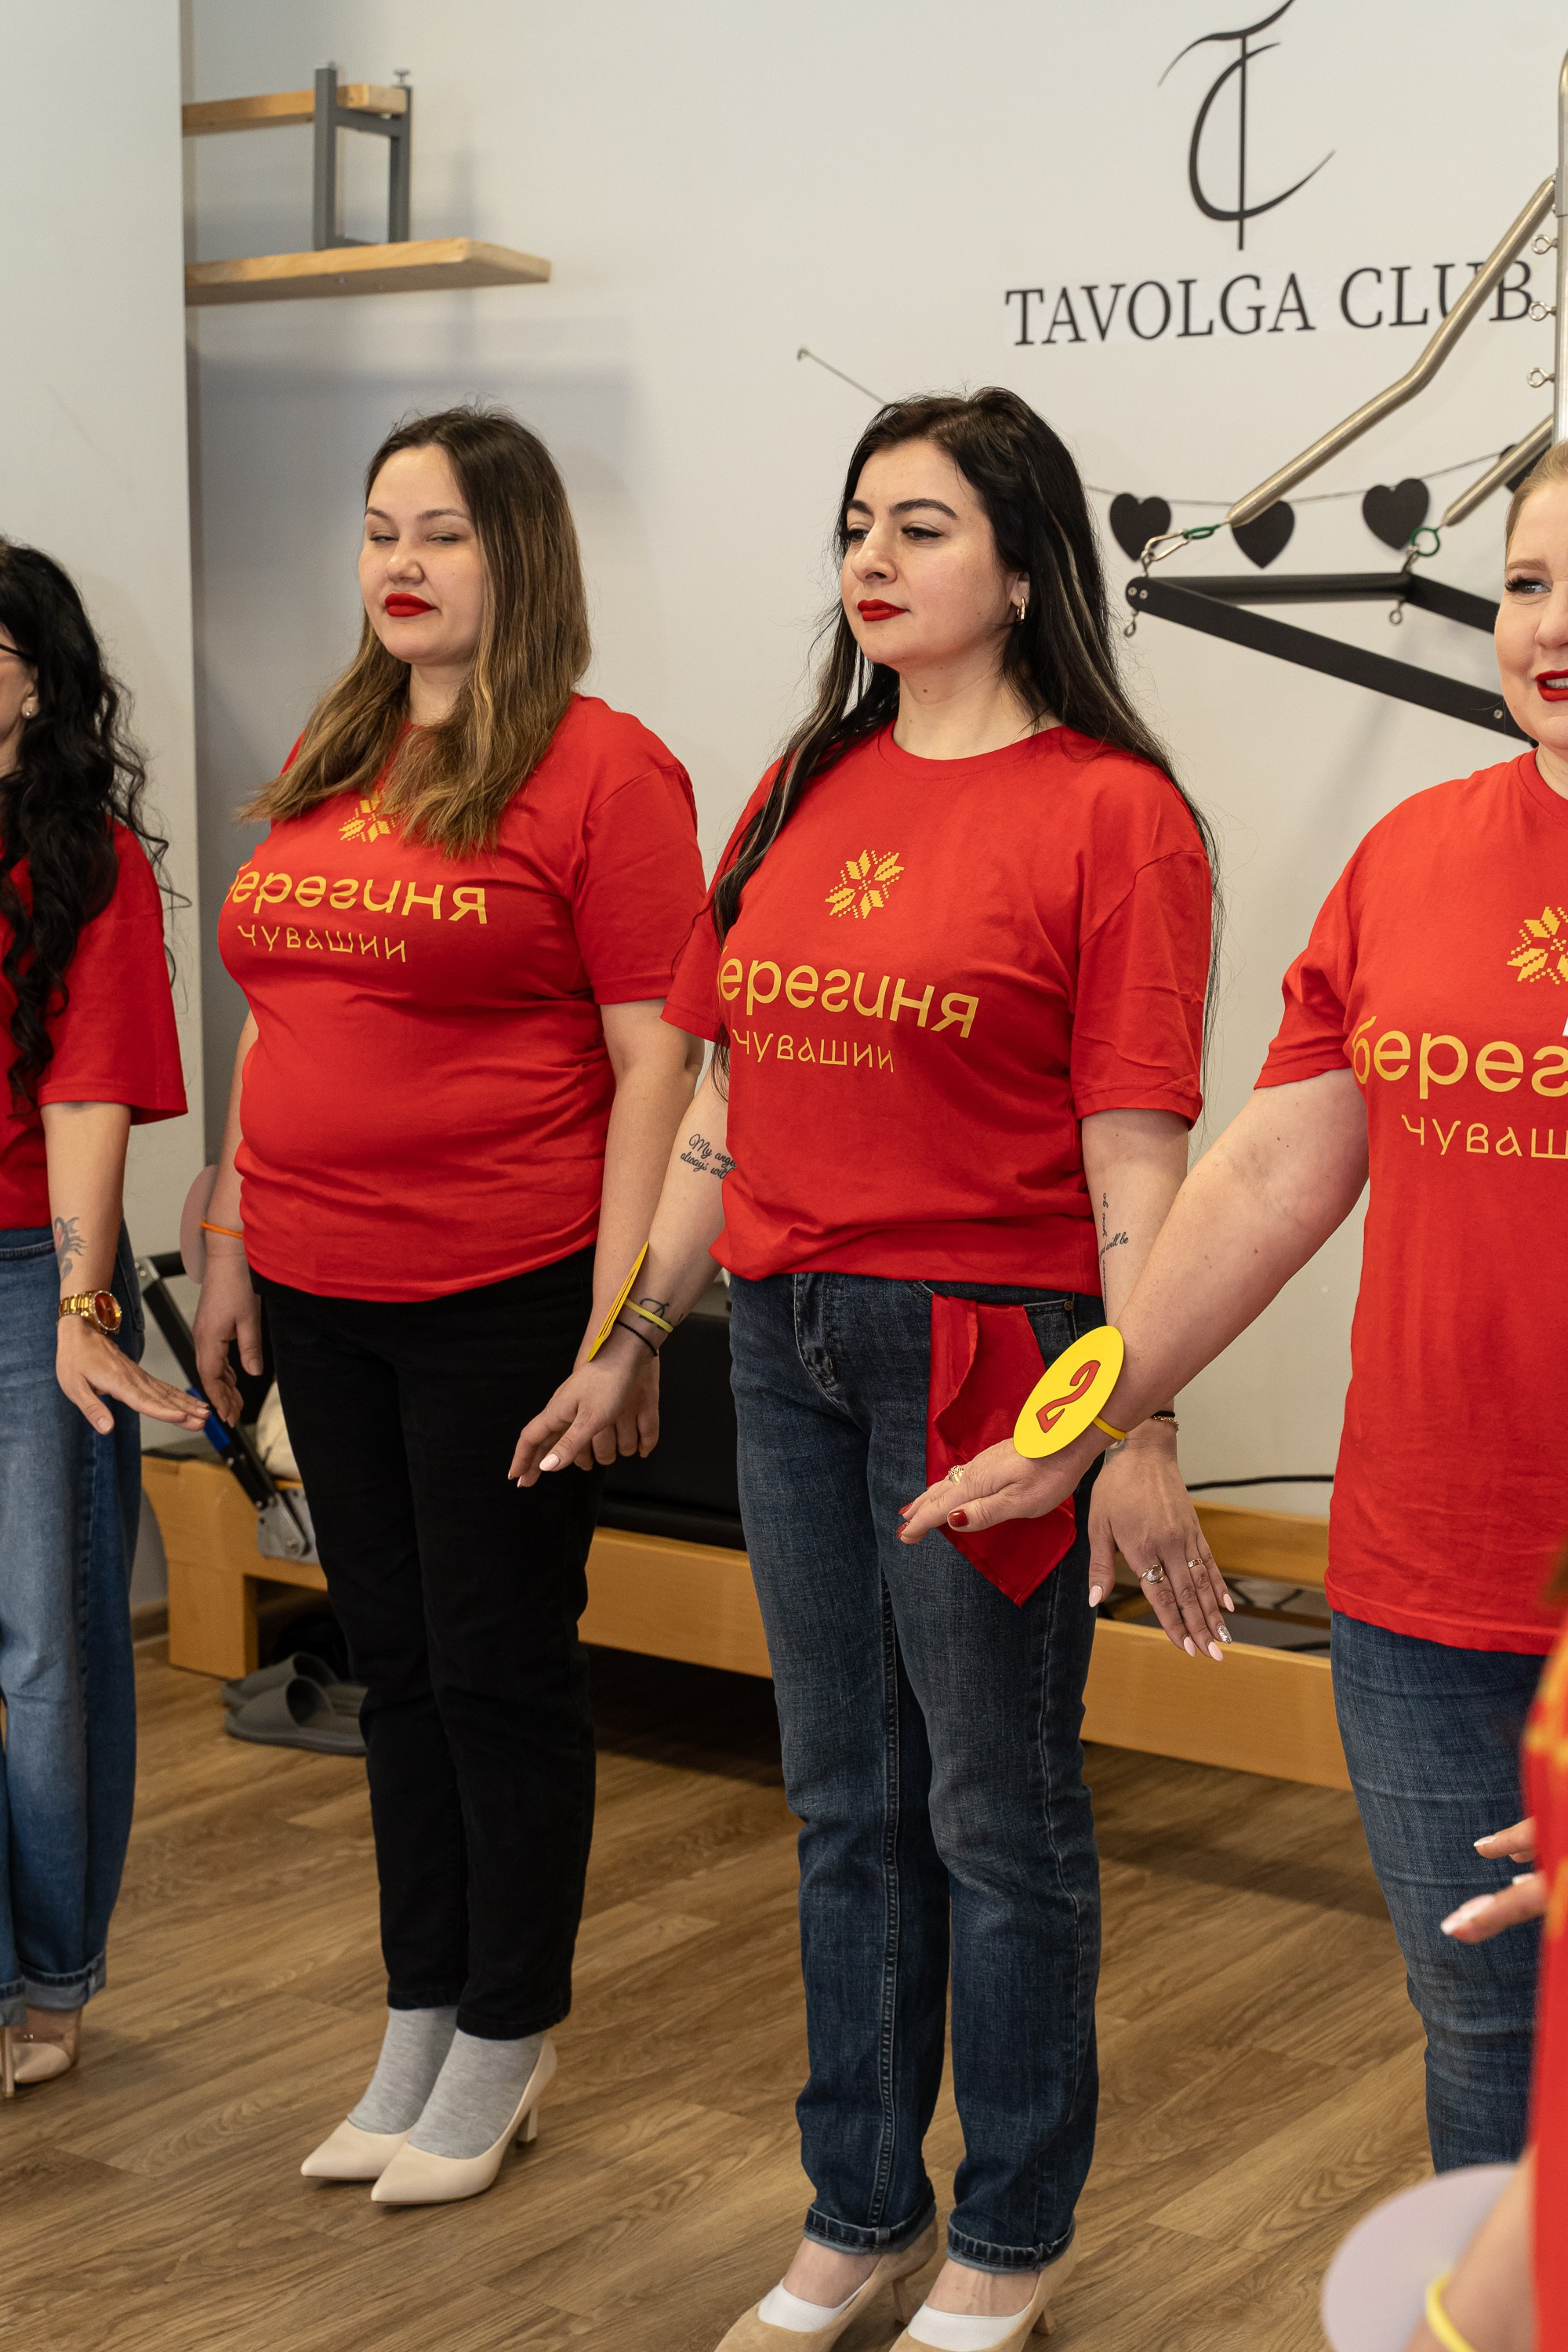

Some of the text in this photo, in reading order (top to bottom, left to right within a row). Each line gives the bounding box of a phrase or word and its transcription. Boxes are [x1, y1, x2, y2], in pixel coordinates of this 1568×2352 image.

[1005, 272, 1316, 347] TAVOLGA
[238, 924, 406, 963] чувашии
[717, 946, 979, 1038] ерегиня
[732, 1029, 895, 1073] чувашии
[680, 1151, 710, 1172] always
[688, 1134, 712, 1159] My
[1119, 1231, 1129, 1245] be
[1036, 1359, 1102, 1434] 2
